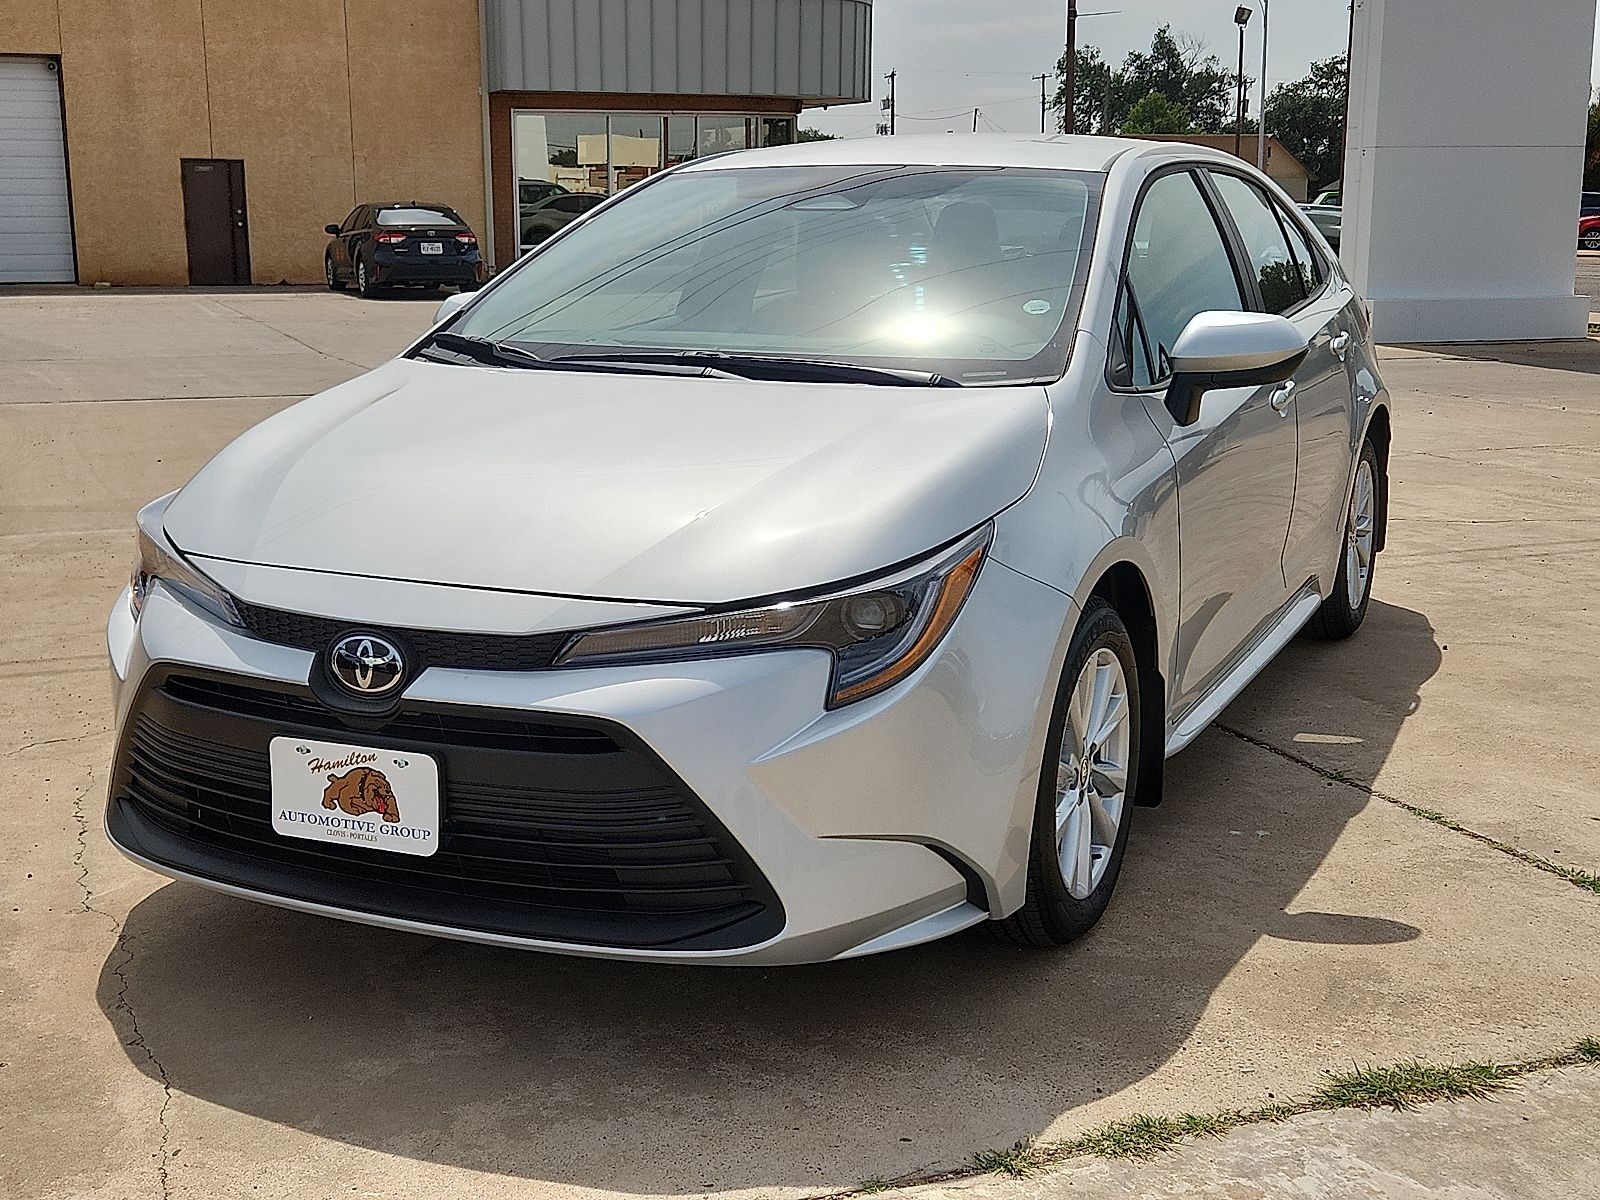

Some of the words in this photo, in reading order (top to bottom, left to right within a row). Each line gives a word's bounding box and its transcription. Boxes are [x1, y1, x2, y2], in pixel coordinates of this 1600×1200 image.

[307, 752, 377, 774] Hamilton
[279, 810, 375, 833] AUTOMOTIVE
[379, 824, 431, 840] GROUP
